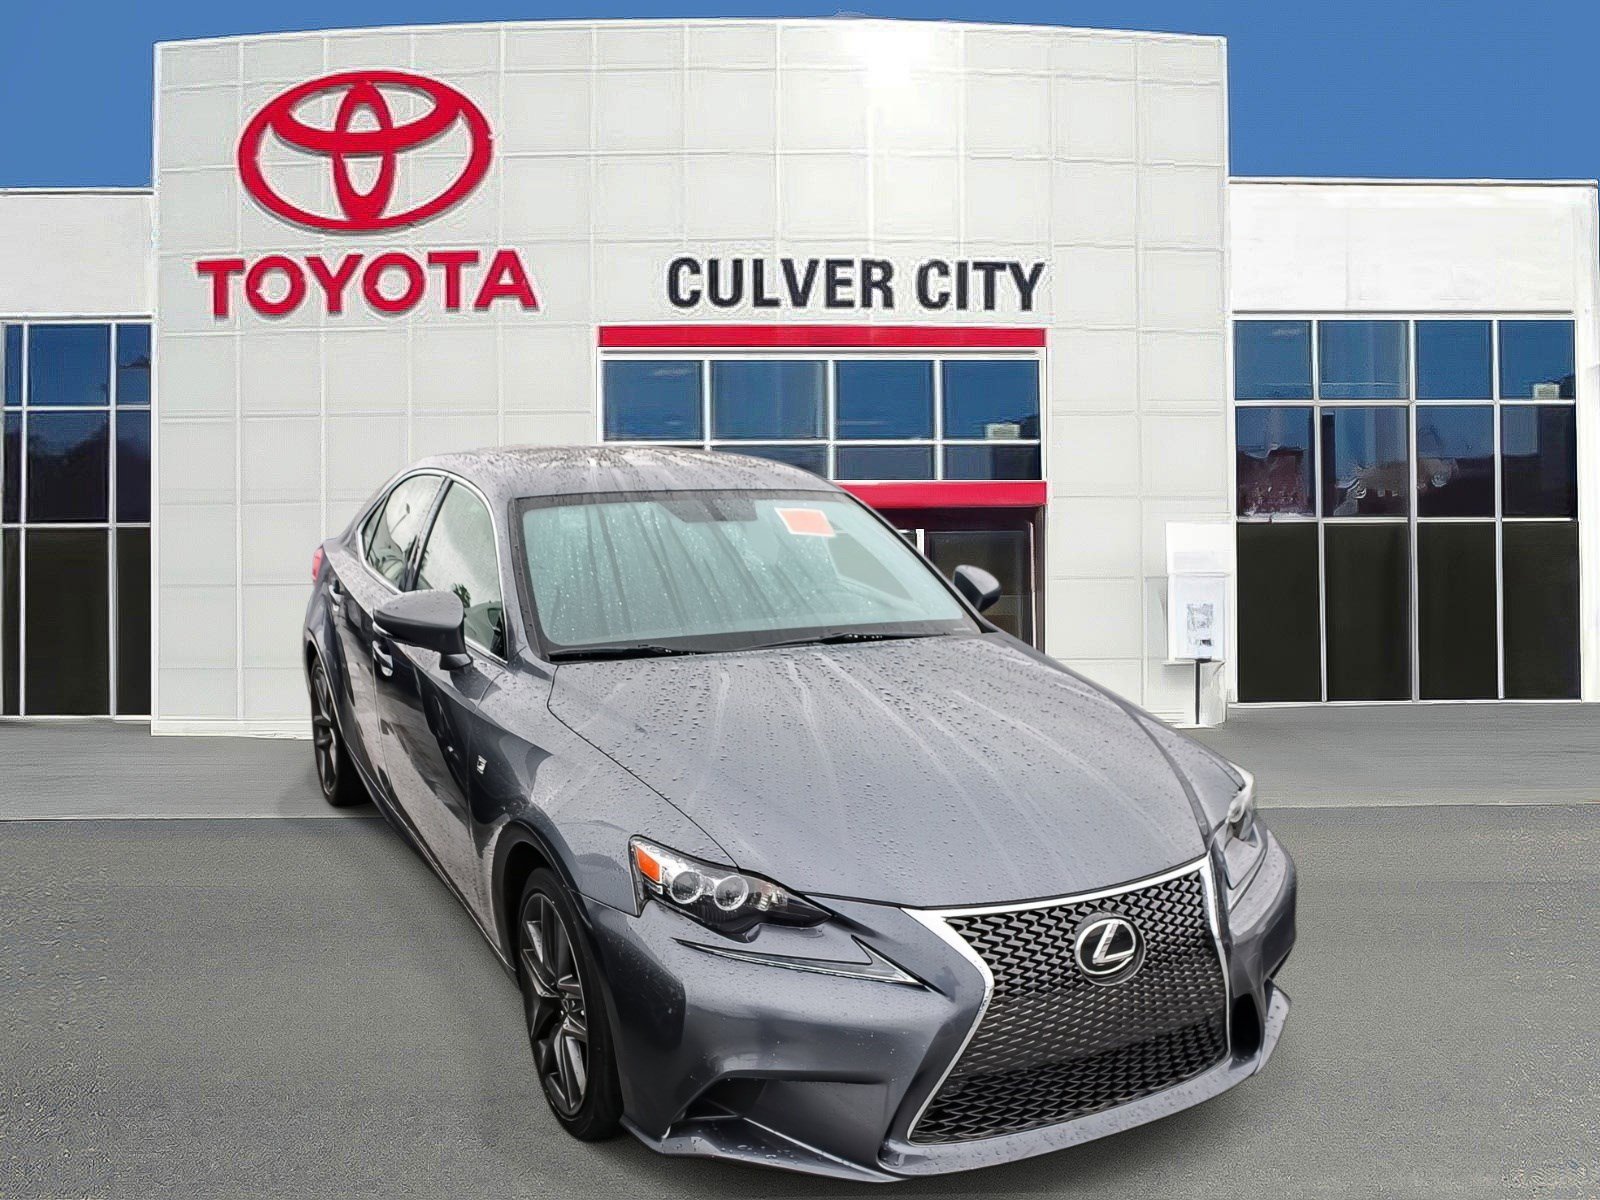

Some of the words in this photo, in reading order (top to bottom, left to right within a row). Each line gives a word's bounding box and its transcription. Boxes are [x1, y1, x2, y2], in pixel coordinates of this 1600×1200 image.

[197, 249, 539, 319] TOYOTA
[668, 257, 895, 309] CULVER
[917, 259, 1045, 311] CITY
